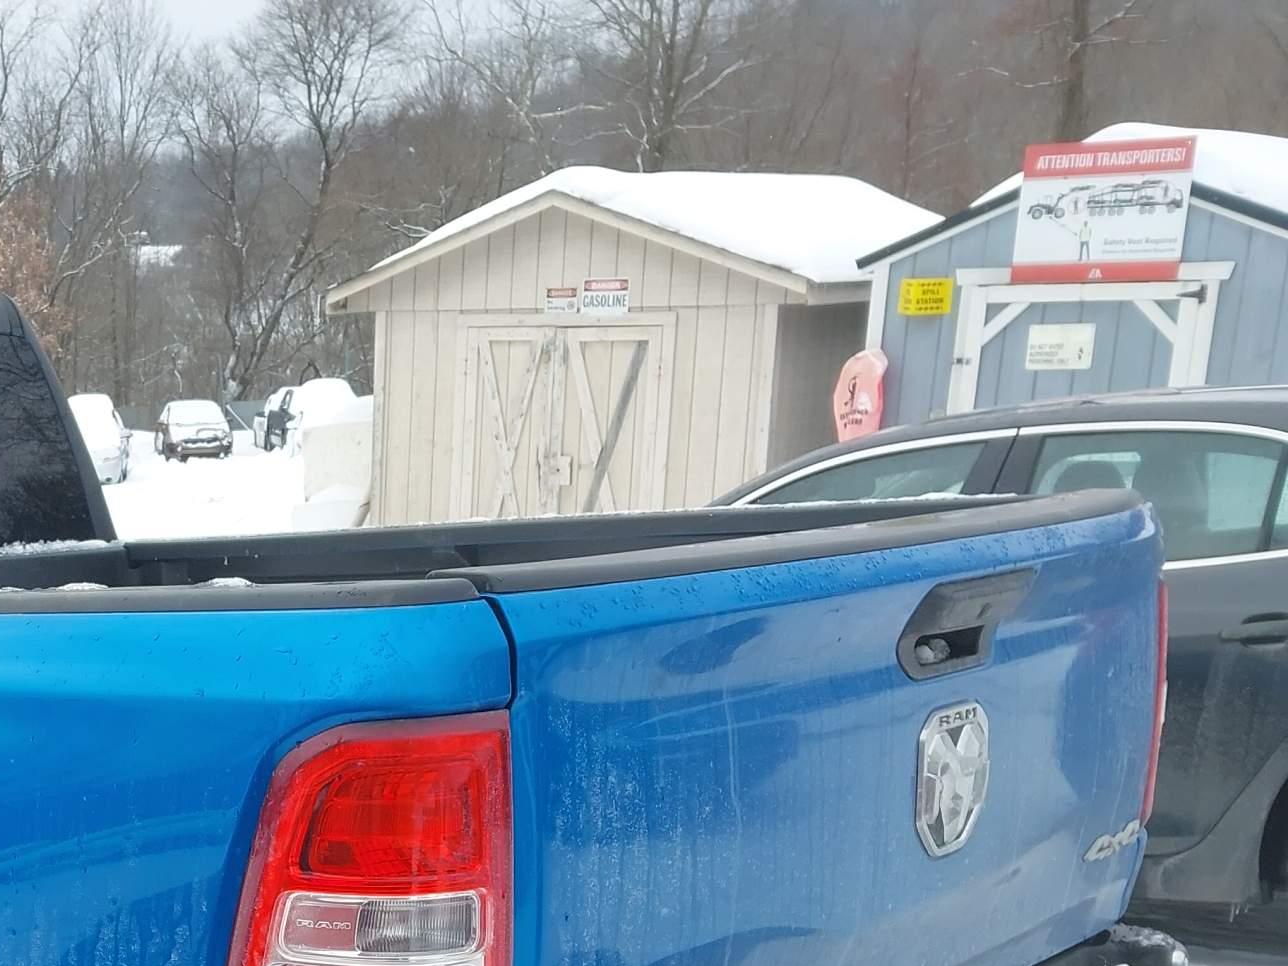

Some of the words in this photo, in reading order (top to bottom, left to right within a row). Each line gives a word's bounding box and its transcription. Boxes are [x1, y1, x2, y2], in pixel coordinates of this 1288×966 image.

[1036, 152, 1094, 170] ATTENTION
[1096, 147, 1187, 167] TRANSPORTERS!
[583, 294, 627, 308] GASOLINE
[939, 706, 977, 727] RAM
[295, 918, 351, 930] RAM
